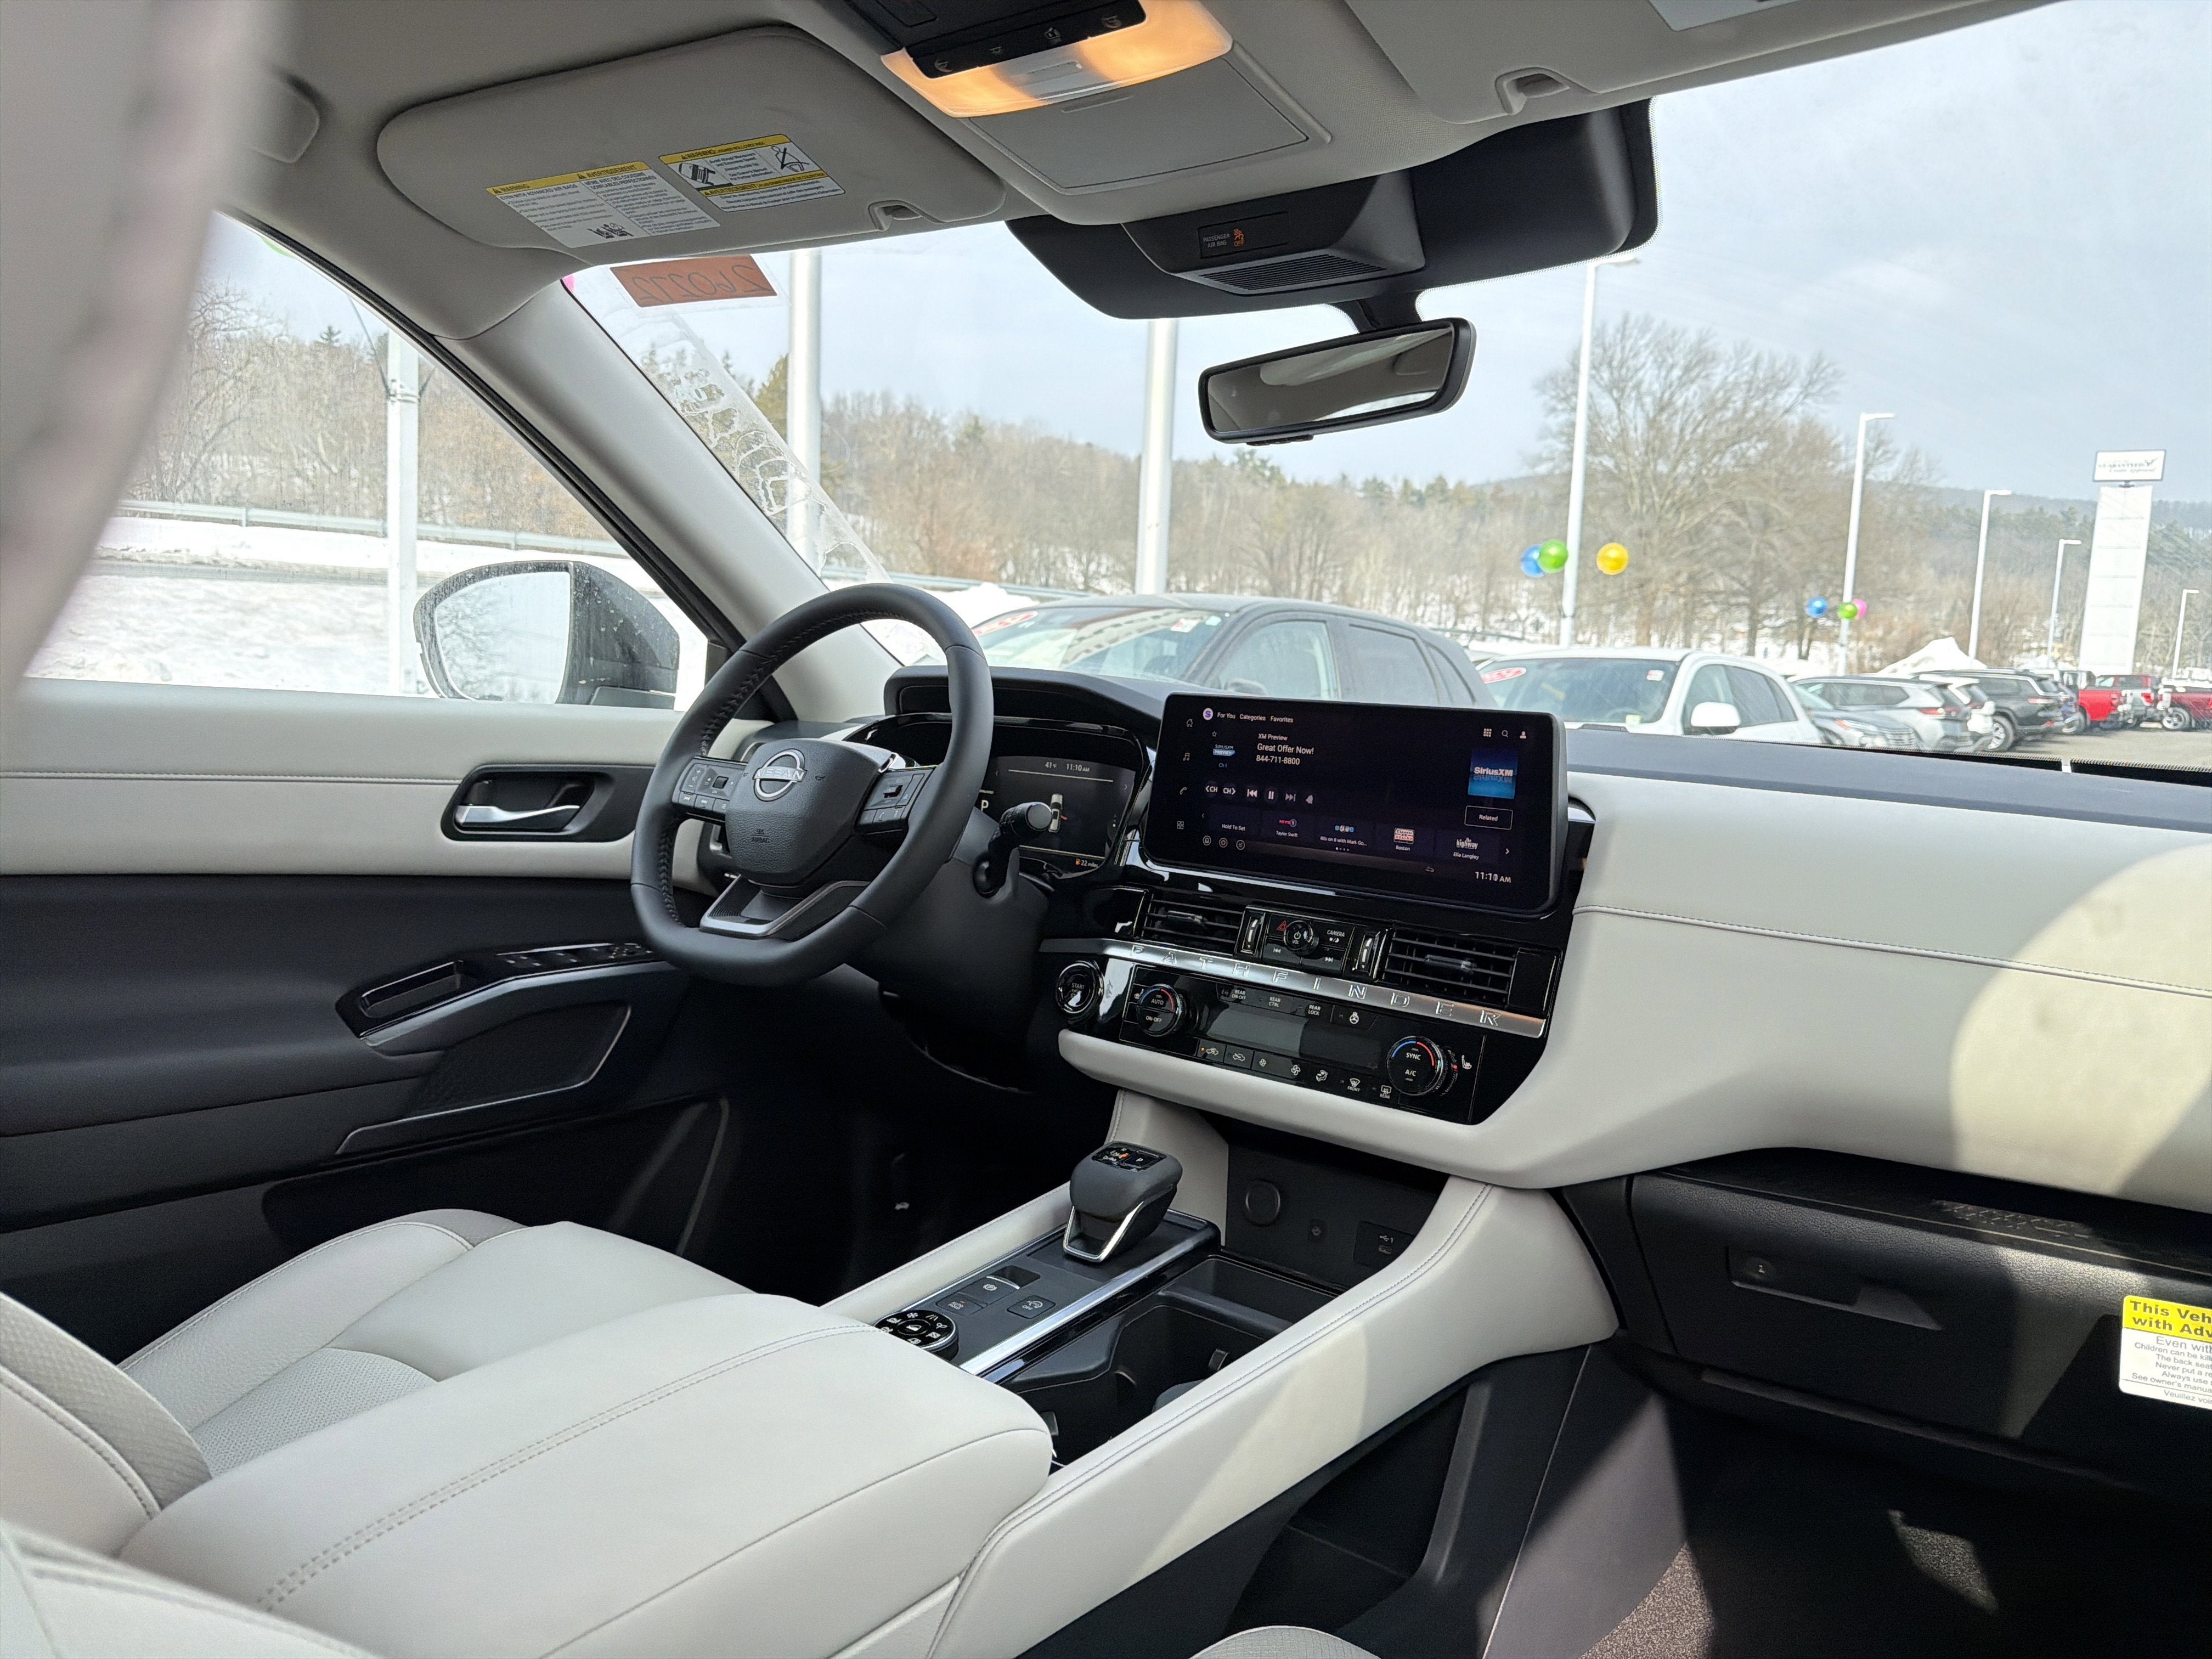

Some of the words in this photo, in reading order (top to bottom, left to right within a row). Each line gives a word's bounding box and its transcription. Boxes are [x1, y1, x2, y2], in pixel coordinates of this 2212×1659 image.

[1203, 233, 1230, 242] PASSENGER
[1257, 743, 1276, 752] Great
[1277, 744, 1294, 753] Offer
[1296, 746, 1314, 754] Now!
[1256, 754, 1300, 765] 844-711-8800
[1066, 763, 1082, 771] 11:10
[1474, 766, 1513, 776] SiriusXM
[981, 799, 989, 812] P
[1456, 838, 1478, 850] highway
[1475, 871, 1498, 882] 11:10
[1130, 944, 1500, 1026] PATHFINDER
[1406, 1052, 1421, 1060] SYNC
[2130, 1300, 2170, 1316] This
[2177, 1308, 2211, 1324] Veh
[2132, 1317, 2172, 1331] with
[2134, 1342, 2168, 1353] Children
[2156, 1335, 2187, 1350] Even
[2155, 1353, 2171, 1362] The
[2174, 1357, 2193, 1366] back
[2155, 1362, 2180, 1371] Never
[2132, 1373, 2148, 1381] See
[2150, 1377, 2182, 1387] owner's
[2162, 1370, 2191, 1382] Always
[2164, 1389, 2196, 1401] Veuillez
